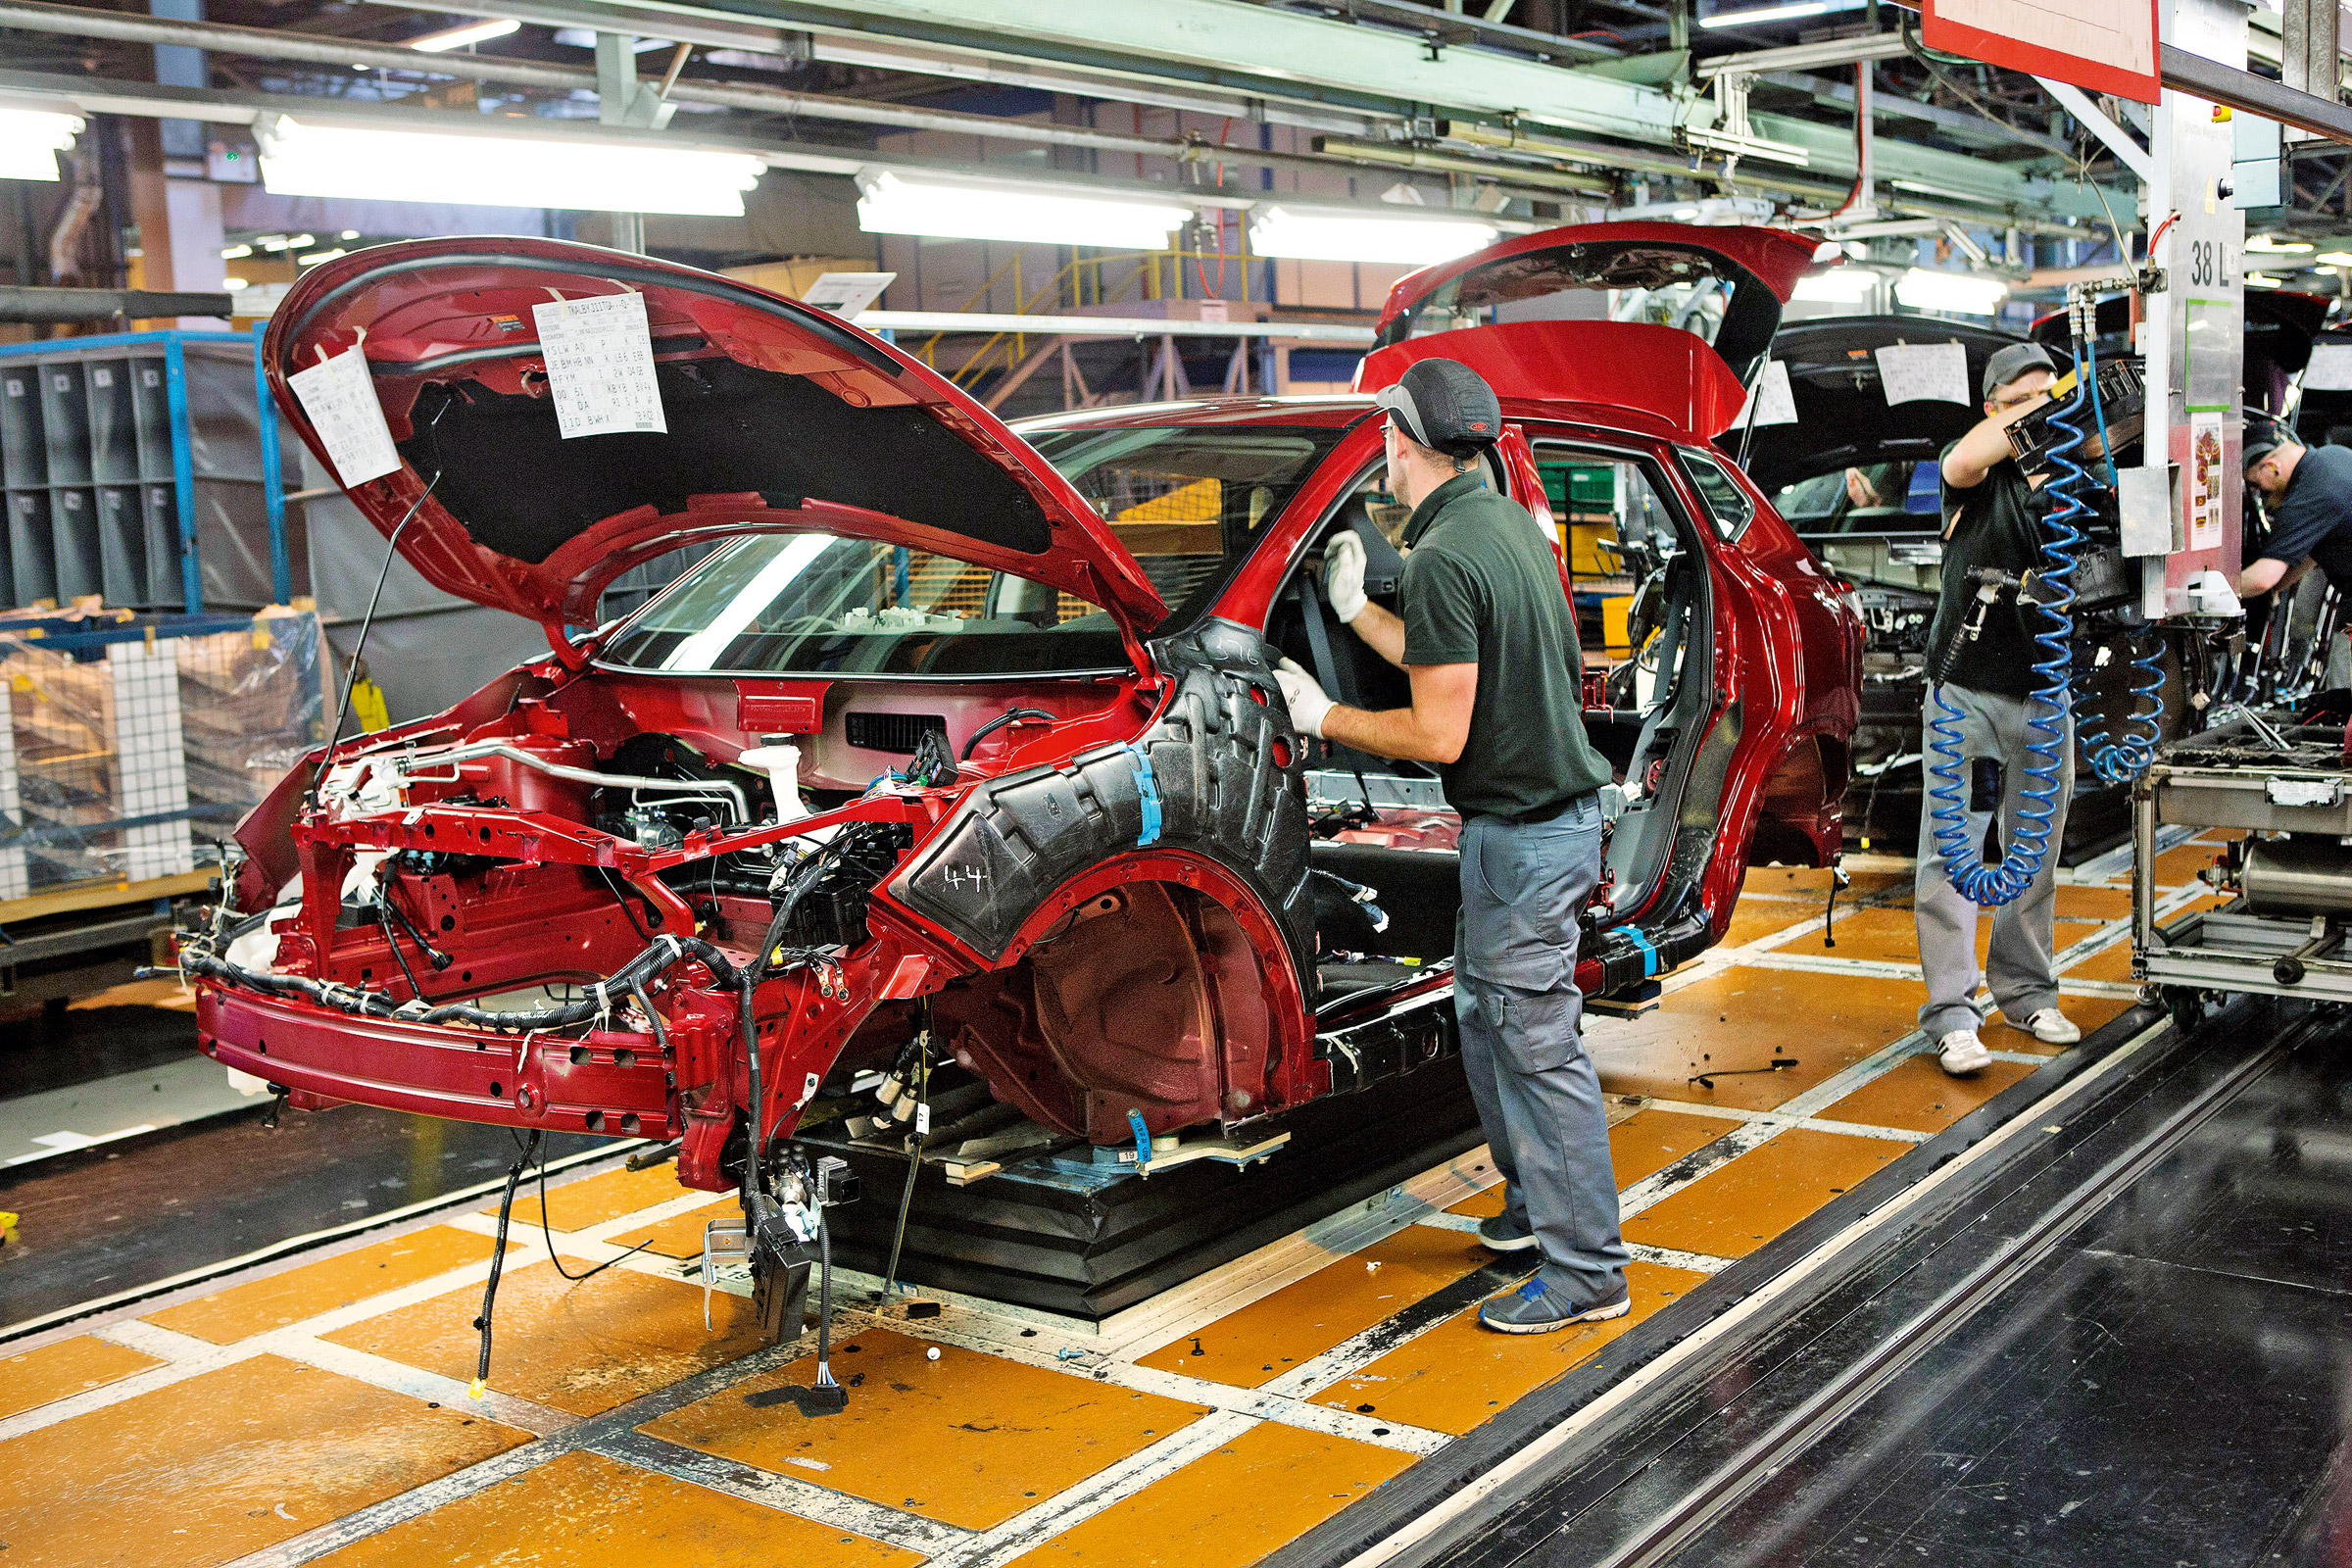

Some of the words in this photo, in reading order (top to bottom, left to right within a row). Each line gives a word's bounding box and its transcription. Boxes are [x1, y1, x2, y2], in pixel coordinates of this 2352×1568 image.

[2191, 240, 2212, 286] 38
[2220, 242, 2229, 287] L
[944, 864, 987, 893] 44
